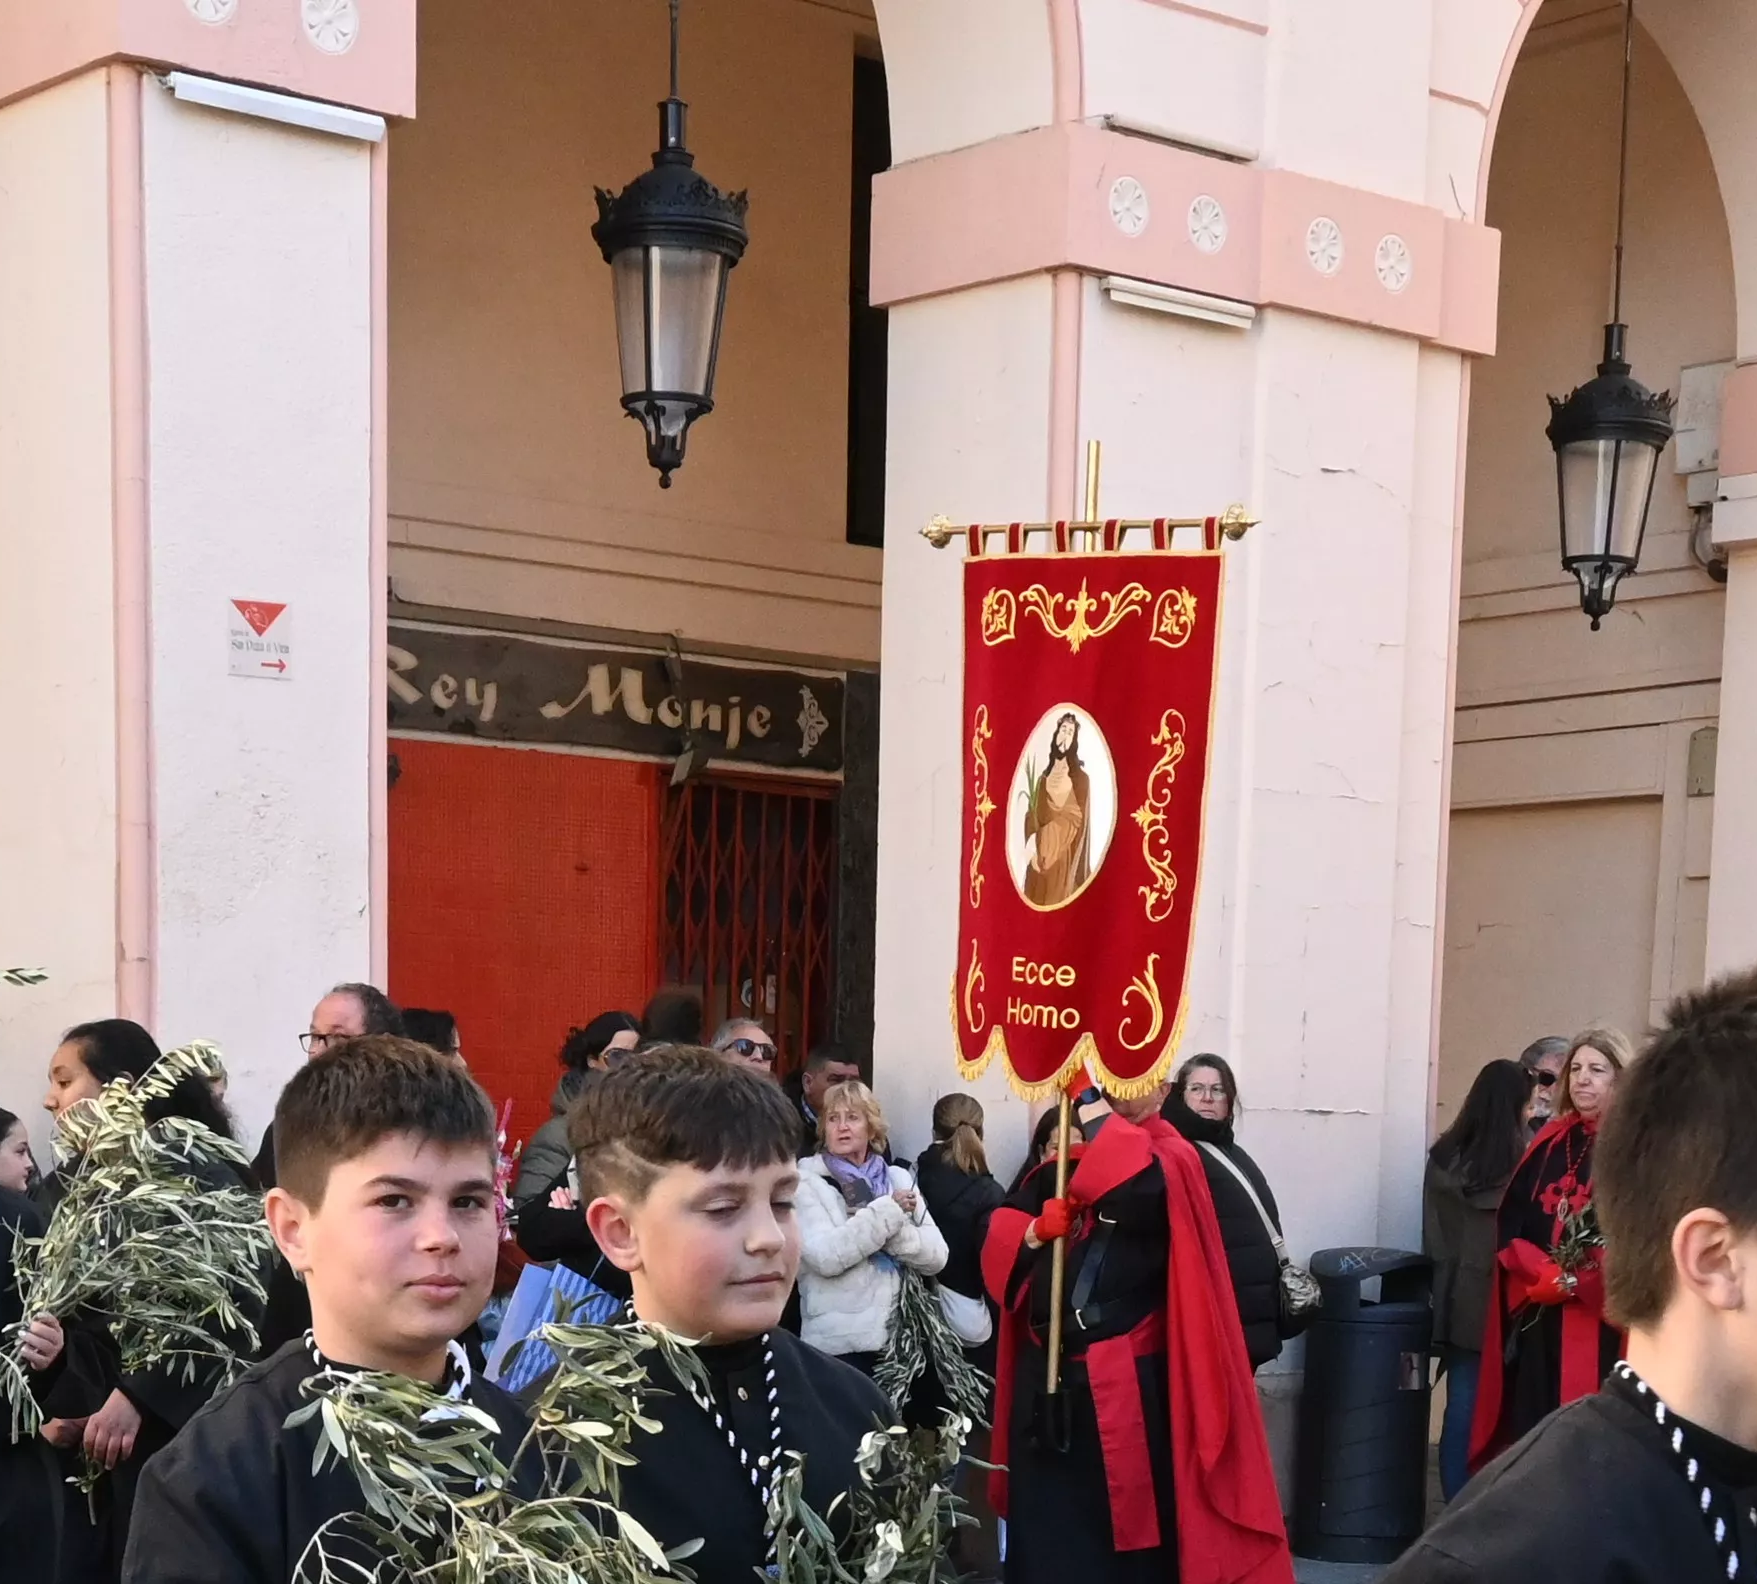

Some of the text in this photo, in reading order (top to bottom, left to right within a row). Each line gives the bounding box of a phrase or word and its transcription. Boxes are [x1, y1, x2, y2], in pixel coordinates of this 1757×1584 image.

[386, 644, 772, 750] Rey Monje
[1012, 956, 1076, 987] Ecce
[1006, 996, 1081, 1029] Homo
